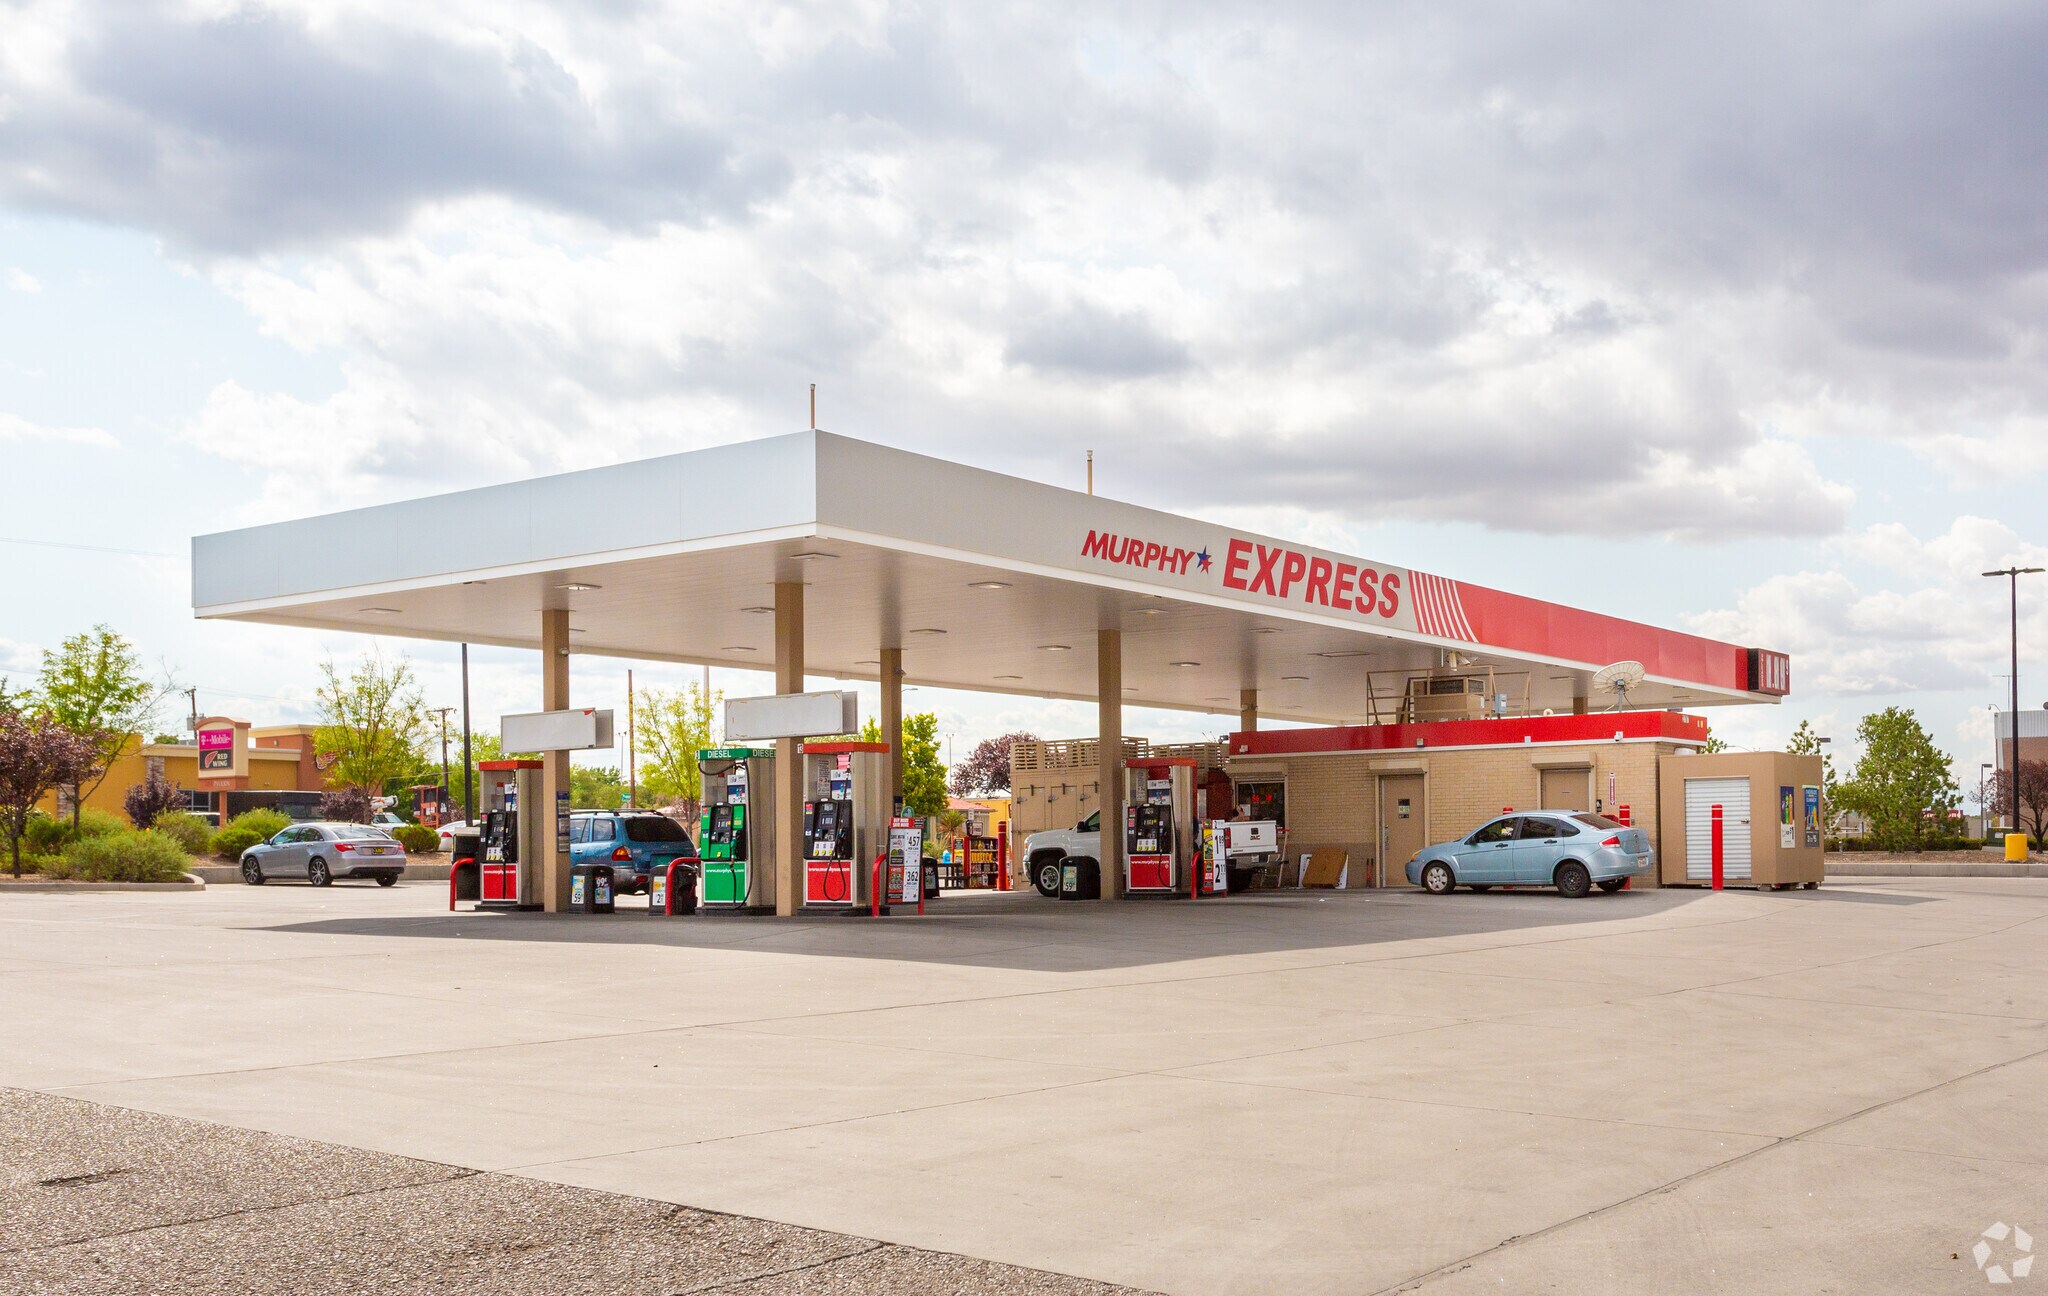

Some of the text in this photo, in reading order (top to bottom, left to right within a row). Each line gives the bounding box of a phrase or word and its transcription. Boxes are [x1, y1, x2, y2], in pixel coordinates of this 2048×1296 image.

[1081, 530, 1401, 618] MURPHY EXPRESS
[707, 750, 732, 758] DIESEL
